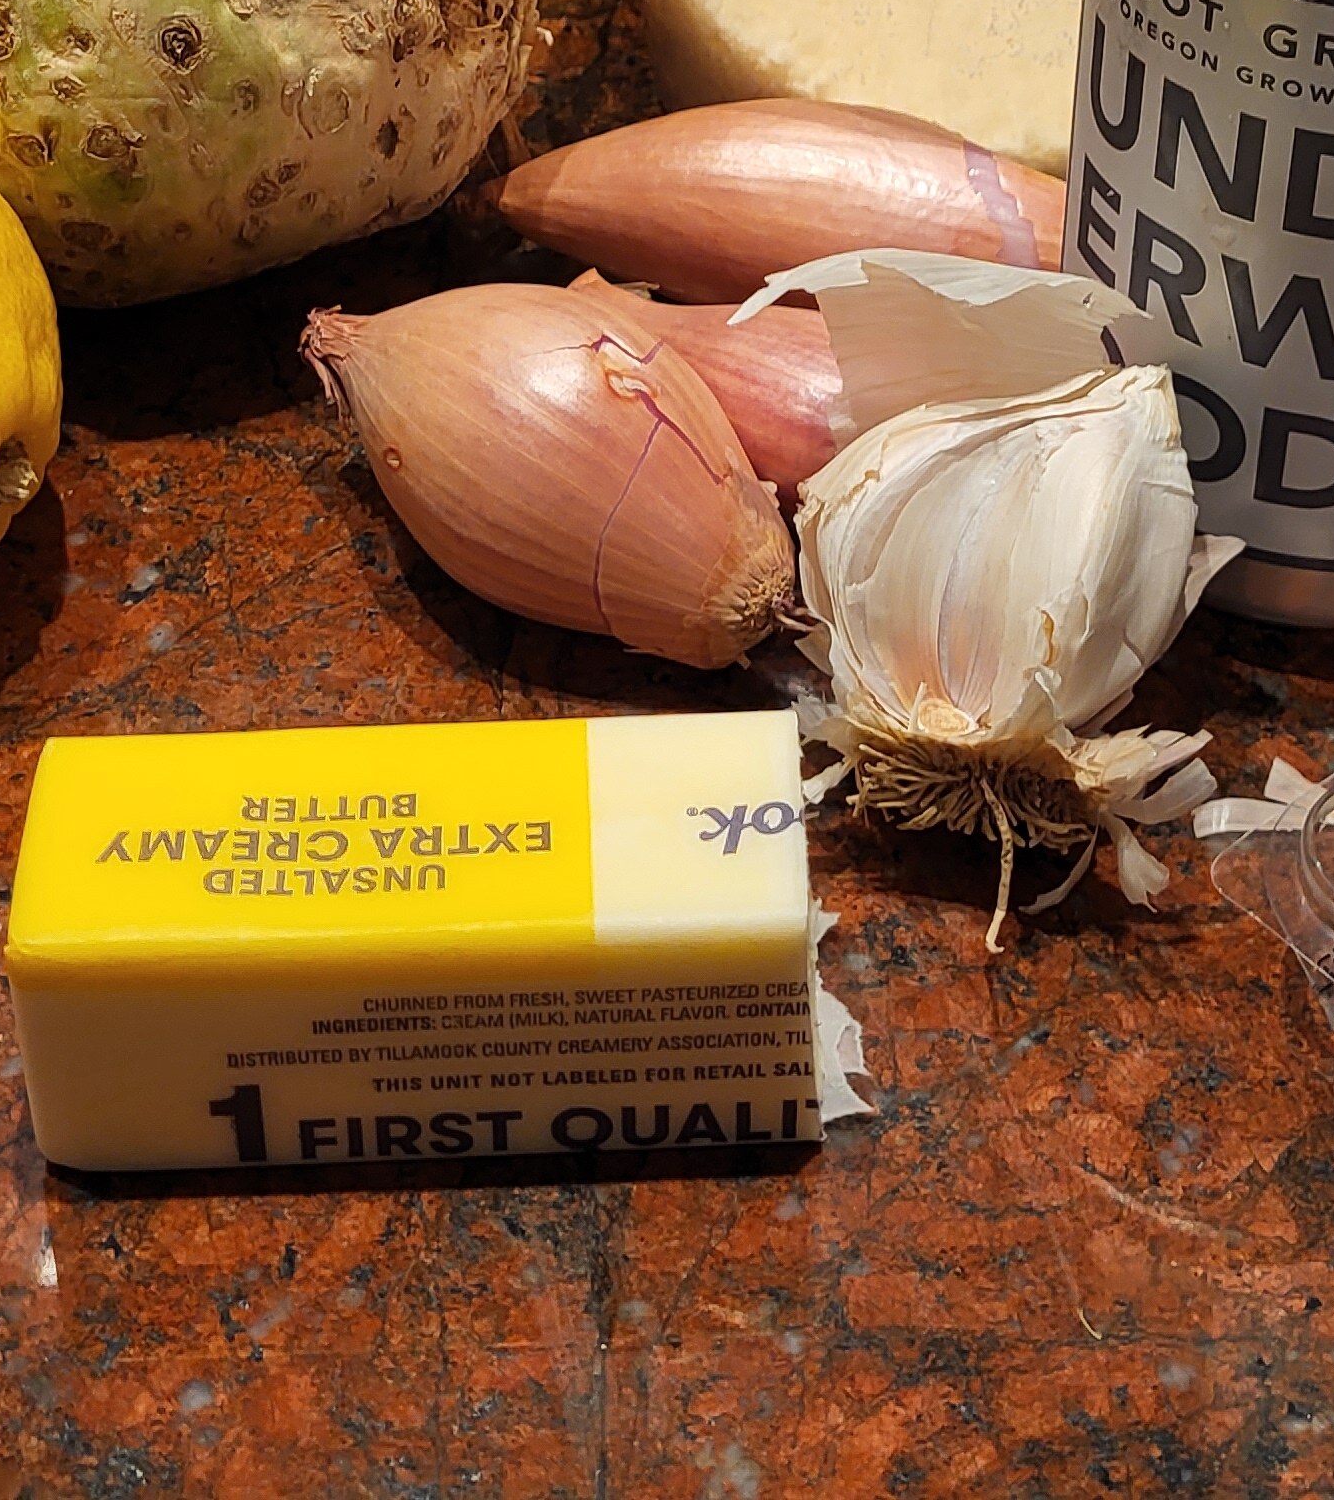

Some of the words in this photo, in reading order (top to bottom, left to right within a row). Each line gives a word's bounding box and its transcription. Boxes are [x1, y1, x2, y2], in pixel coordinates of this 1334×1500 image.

[1120, 0, 1219, 73] OREGON
[241, 792, 418, 823] BUTTER
[94, 829, 349, 865] CREAMY
[367, 820, 553, 859] EXTRA
[203, 864, 446, 896] UNSALTED
[363, 995, 448, 1013] CHURNED
[453, 993, 505, 1009] FROM
[510, 991, 570, 1008] FRESH,
[575, 988, 637, 1005] SWEET
[641, 983, 759, 1003] PASTEURIZED
[312, 1016, 437, 1035] INGREDIENTS:
[441, 1013, 505, 1030] CREAM
[509, 1010, 569, 1030] (MILK),
[574, 1007, 656, 1026] NATURAL
[226, 1048, 342, 1069] DISTRIBUTED
[349, 1047, 371, 1063] BY
[375, 1043, 478, 1061] TILLAMOOK
[482, 1040, 552, 1057] COUNTY
[557, 1036, 653, 1055] CREAMERY
[657, 1031, 781, 1051] ASSOCIATION,
[372, 1077, 422, 1092] THIS
[430, 1074, 483, 1090] UNIT
[490, 1072, 535, 1088] NOT
[543, 1069, 637, 1085] LABELED
[645, 1067, 686, 1082] FOR
[693, 1063, 766, 1080] RETAIL
[209, 1084, 267, 1162] 1
[298, 1110, 523, 1160] FIRST
